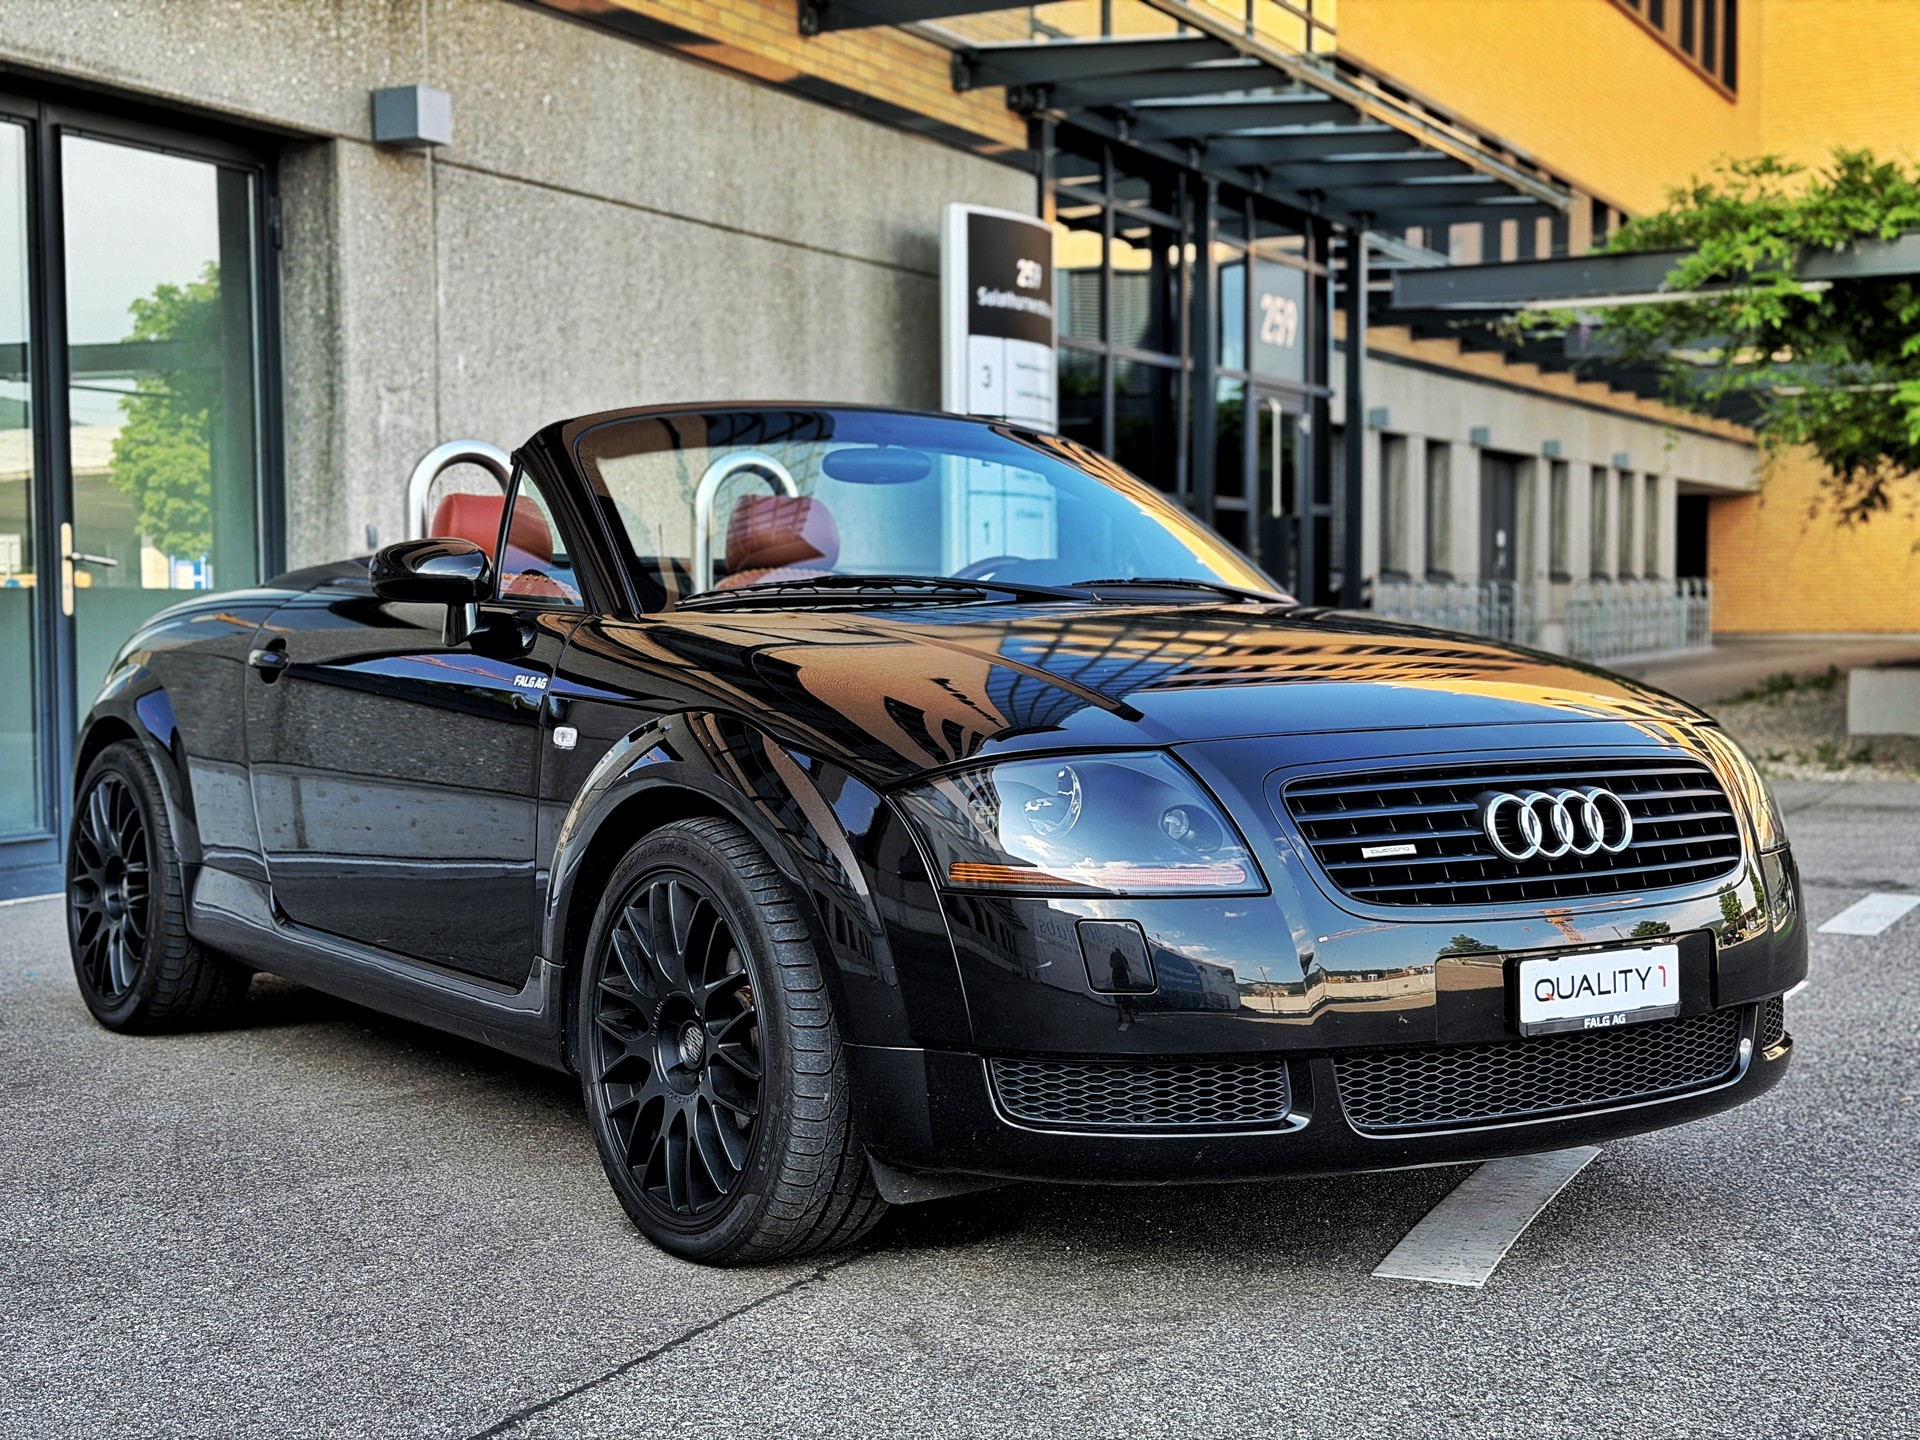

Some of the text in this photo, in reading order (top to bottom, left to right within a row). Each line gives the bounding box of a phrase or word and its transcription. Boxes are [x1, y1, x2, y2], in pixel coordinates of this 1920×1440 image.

[1016, 258, 1043, 289] 259
[1260, 292, 1298, 349] 259
[982, 366, 992, 387] 3
[513, 674, 548, 699] FALG AG
[1370, 846, 1410, 855] quattro
[1534, 965, 1667, 1002] QUALITY 1
[1584, 1013, 1626, 1030] FALG AG
